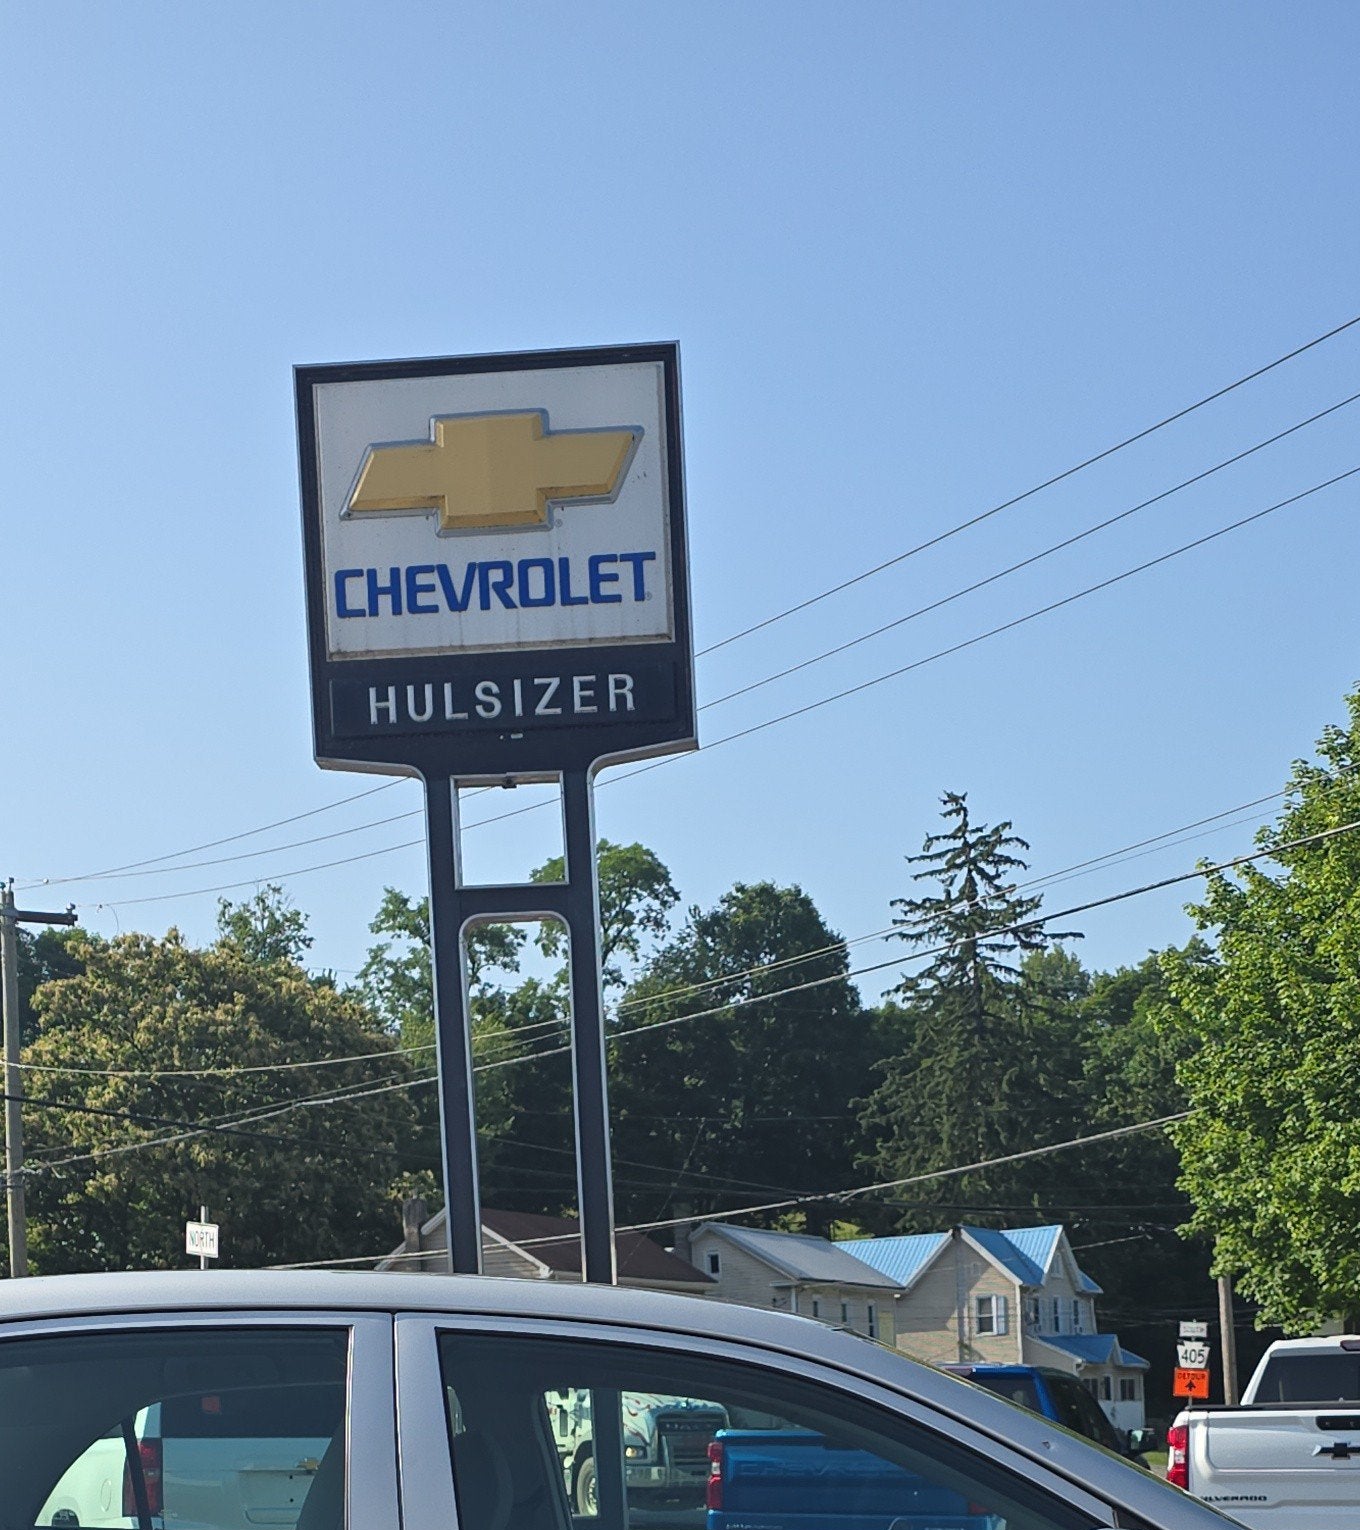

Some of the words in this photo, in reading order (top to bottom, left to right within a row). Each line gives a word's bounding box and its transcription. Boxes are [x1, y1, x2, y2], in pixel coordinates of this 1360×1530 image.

[334, 551, 656, 618] CHEVROLET
[368, 673, 635, 725] HULSIZER
[189, 1230, 215, 1249] NORTH
[1181, 1348, 1205, 1364] 405
[1177, 1372, 1206, 1381] DETOUR
